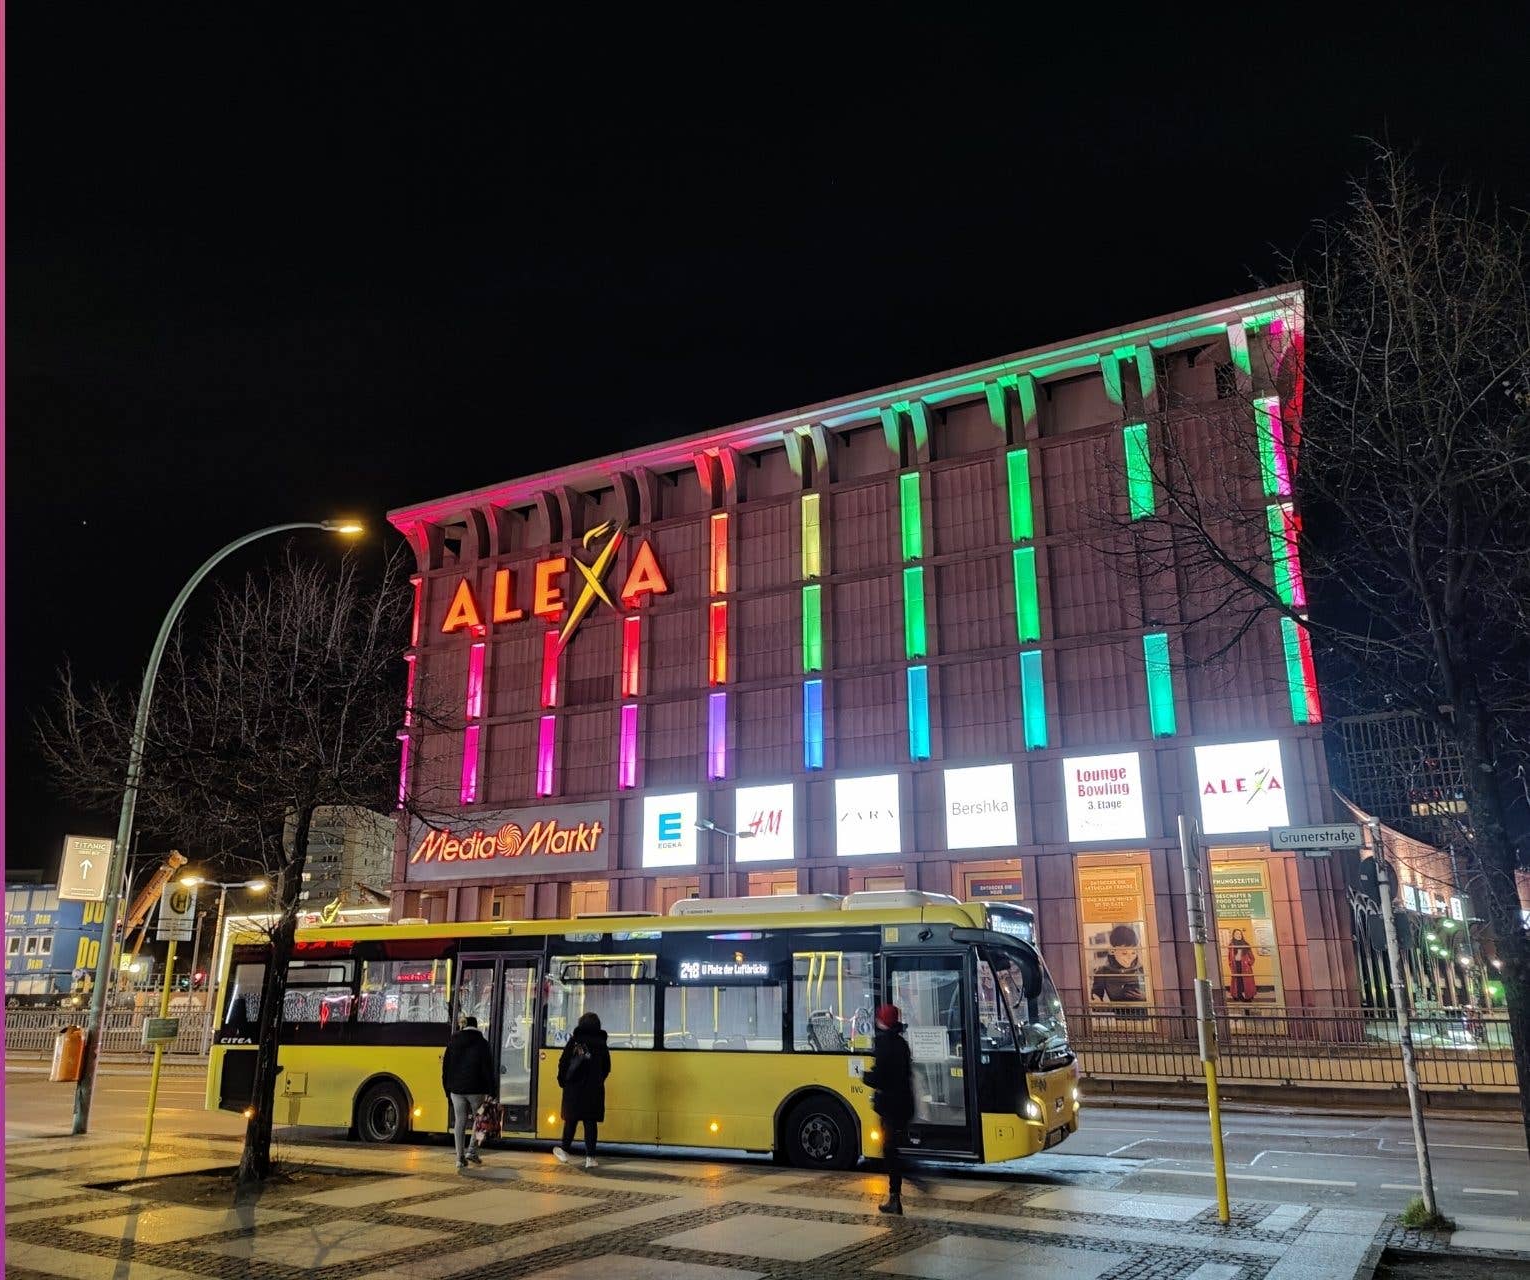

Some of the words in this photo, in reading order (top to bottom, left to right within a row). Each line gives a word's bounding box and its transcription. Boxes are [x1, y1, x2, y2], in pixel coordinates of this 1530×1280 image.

[440, 520, 668, 656] ALEXA
[1076, 767, 1127, 783] Lounge
[1077, 782, 1130, 798] Bowling
[1203, 768, 1283, 804] ALEXA
[951, 799, 1010, 816] Bershka
[1097, 800, 1122, 811] Etage
[1278, 828, 1356, 845] Grunerstraße
[73, 841, 106, 850] TITANIC
[657, 842, 682, 850] EDEKA
[680, 962, 700, 979] 248
[708, 964, 723, 975] Platz
[723, 964, 734, 975] der
